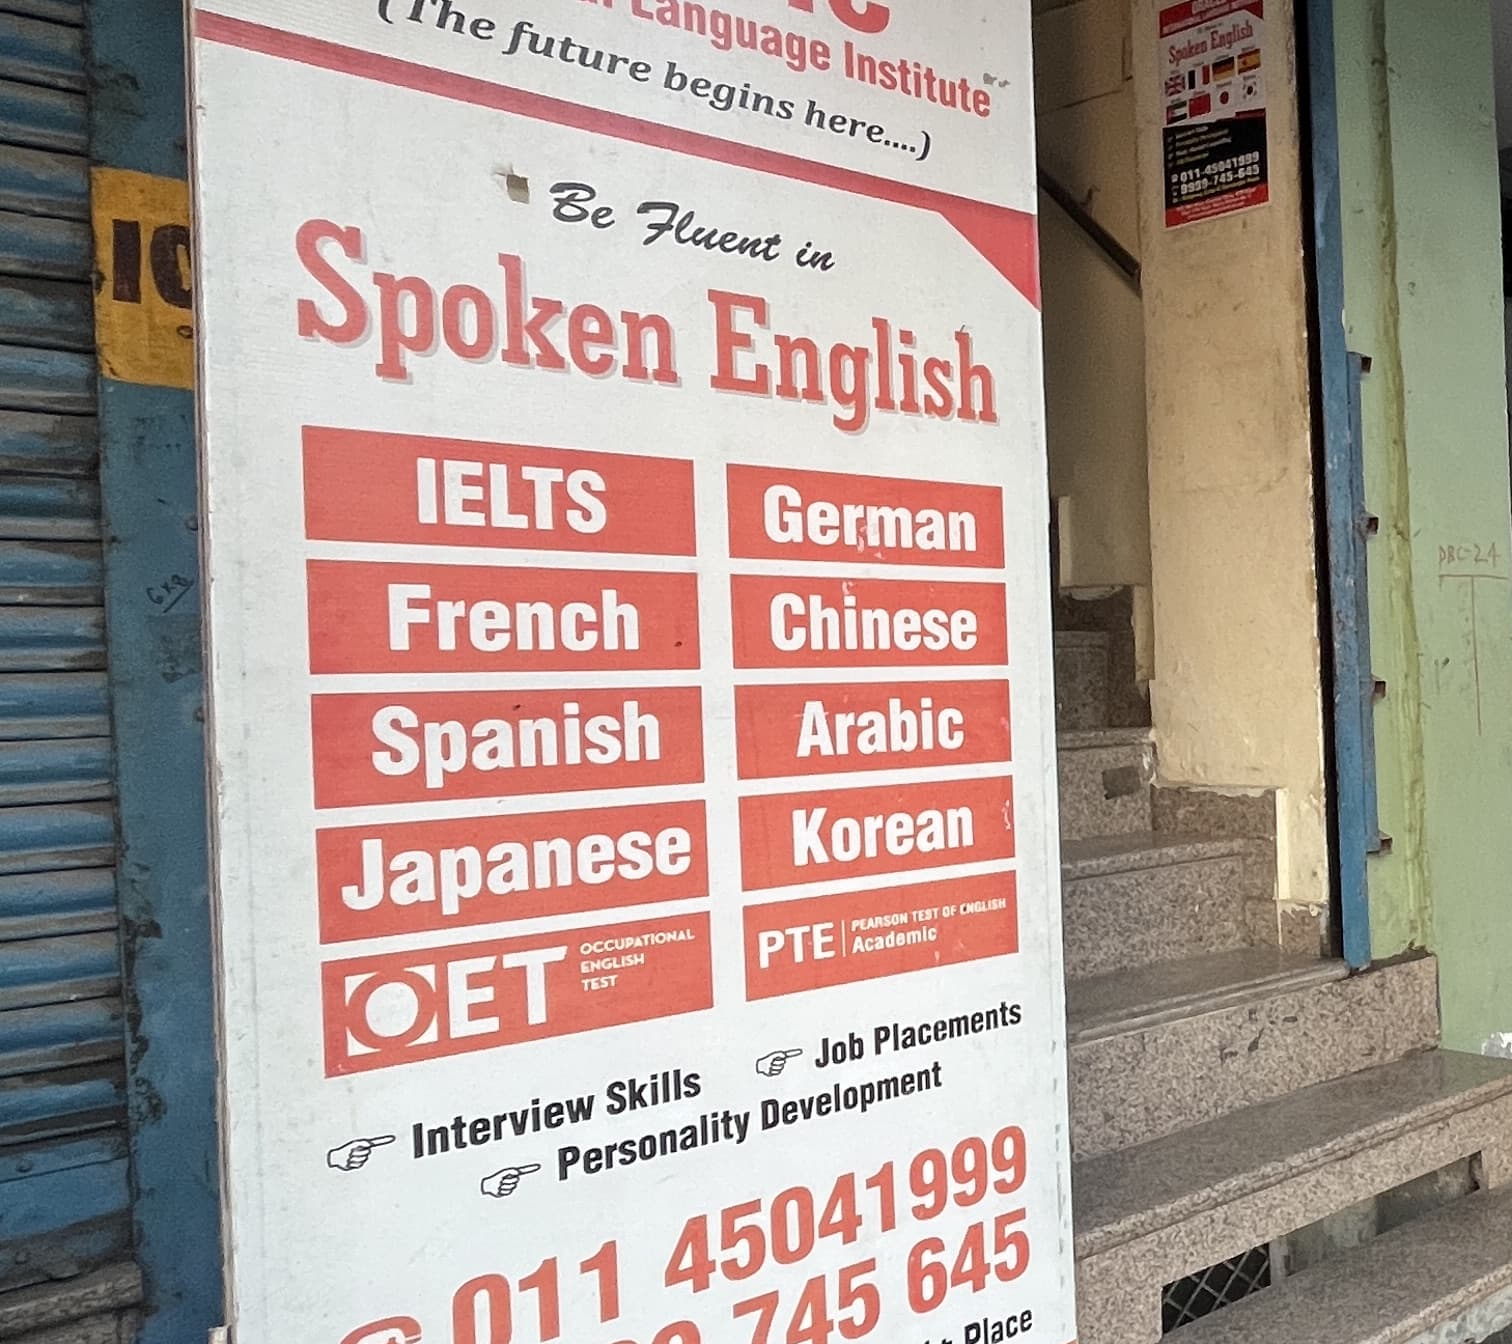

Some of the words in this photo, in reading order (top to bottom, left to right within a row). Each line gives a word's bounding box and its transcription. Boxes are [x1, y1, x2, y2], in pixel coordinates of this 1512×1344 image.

[1168, 40, 1207, 66] Spoken
[1210, 21, 1253, 50] English
[502, 18, 652, 84] future
[664, 61, 794, 122] begins
[804, 99, 933, 161] here....)
[843, 41, 992, 118] Institute
[549, 181, 615, 231] Be
[636, 200, 781, 262] Fluent
[794, 239, 834, 273] in
[297, 218, 681, 386] Spoken
[708, 289, 998, 433] English
[416, 458, 607, 534] IELTS
[763, 484, 977, 553] German
[388, 583, 640, 652] French
[769, 594, 978, 651] Chinese
[371, 702, 661, 788] Spanish
[797, 700, 965, 758] Arabic
[341, 822, 691, 913] Japanese
[791, 801, 974, 866] Korean
[579, 928, 695, 956] OCCUPATIONAL
[758, 922, 836, 969] PTE
[851, 913, 909, 932] PEARSON
[912, 908, 939, 923] TEST
[942, 905, 957, 918] OF
[852, 926, 937, 954] Academic
[580, 954, 645, 974] ENGLISH
[581, 974, 618, 991] TEST
[814, 1034, 865, 1071] Job
[873, 1000, 1022, 1055] Placements
[411, 1094, 595, 1160] Interview
[605, 1068, 702, 1117] Skills
[558, 1111, 750, 1182] Personality
[761, 1061, 943, 1129] Development
[664, 1125, 1027, 1294] 45041999
[906, 1207, 1029, 1307] 645
